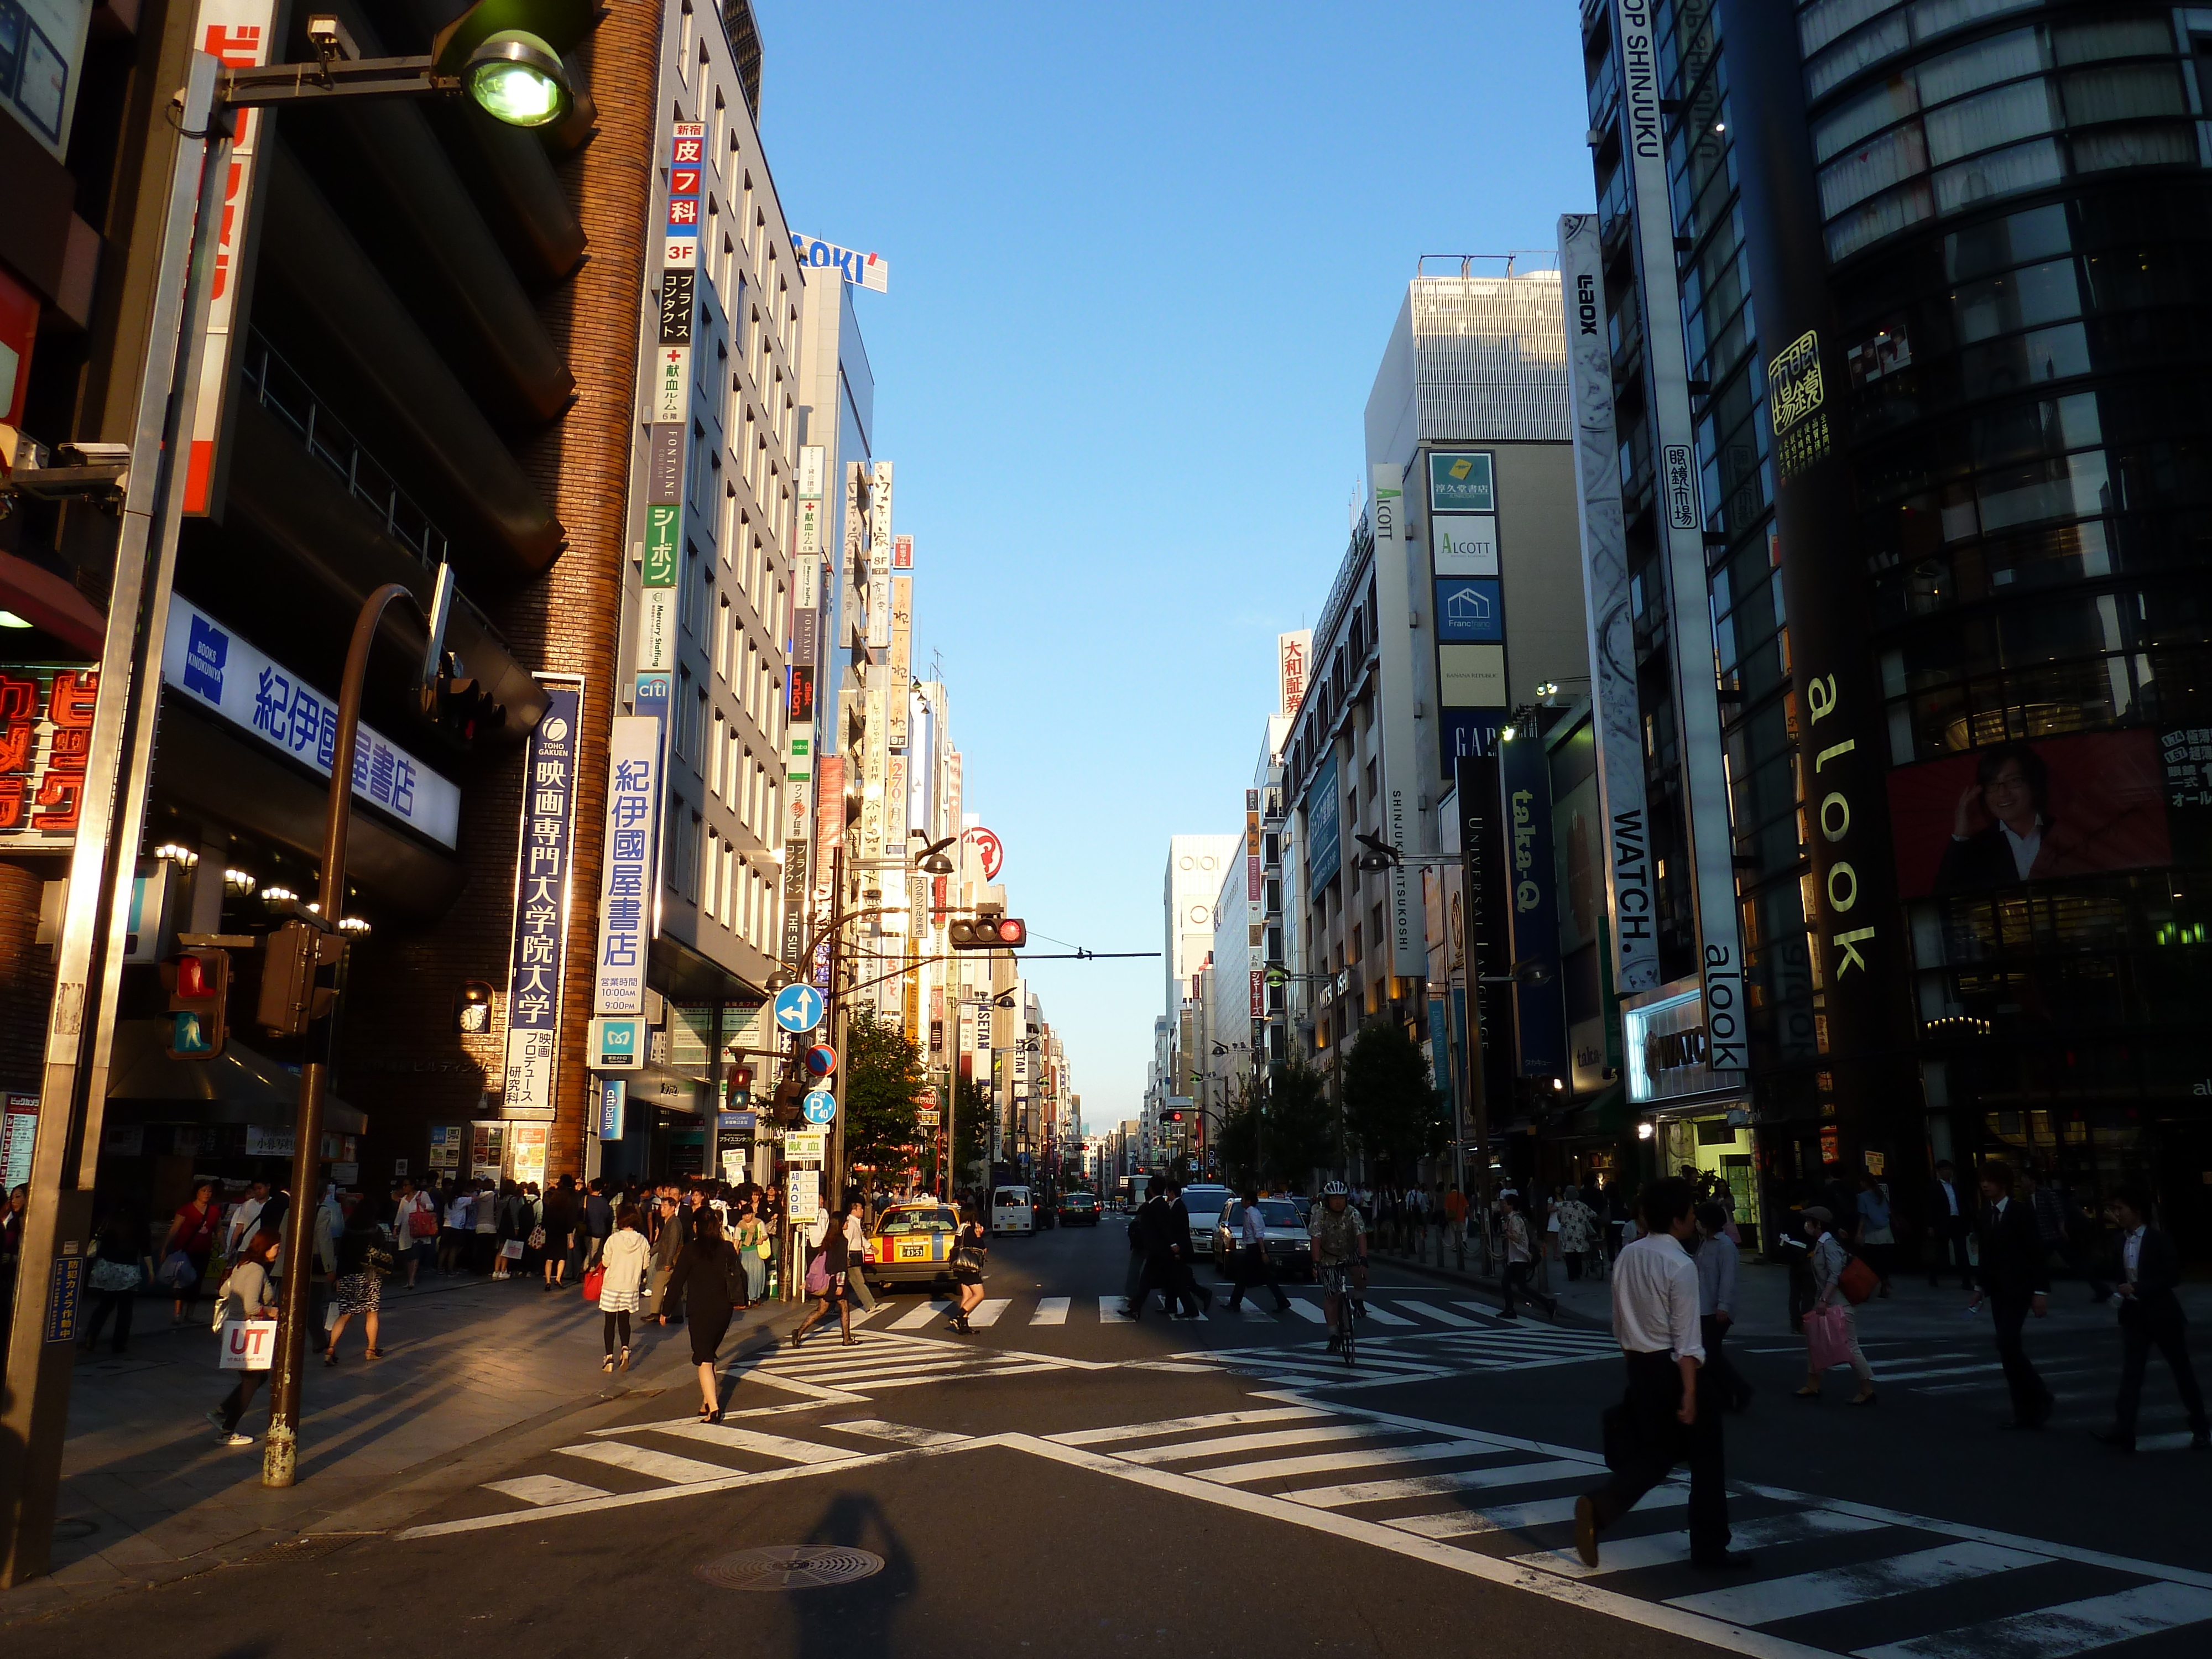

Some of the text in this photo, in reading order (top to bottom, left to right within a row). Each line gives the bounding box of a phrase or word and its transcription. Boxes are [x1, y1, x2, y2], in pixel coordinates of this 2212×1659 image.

[1626, 34, 1658, 158] SHINJUKU
[677, 125, 701, 135] 新宿
[671, 140, 699, 223] 皮フ科
[668, 247, 693, 259] 3F
[662, 275, 677, 337] コンタクト
[676, 275, 694, 337] プライス
[665, 364, 679, 410] 献血ルーム
[665, 431, 677, 497] FONTAINE
[1435, 484, 1488, 493] 淳久堂書店
[1669, 448, 1692, 526] 眼鏡市場
[804, 513, 813, 544] 献血ルーム
[1376, 486, 1401, 540] ALCOTT
[1442, 533, 1490, 554] ALCOTT
[197, 641, 217, 664] BOOKS
[652, 638, 662, 667] Staffing
[803, 614, 812, 660] FONTAINE
[188, 651, 221, 683] KINOKUNIYA
[1284, 640, 1302, 714] 大和証券
[639, 681, 666, 697] citi
[792, 671, 801, 716] union
[2163, 732, 2184, 746] 1.74
[2167, 748, 2185, 763] 1.67
[871, 750, 879, 780] 日本料理
[2169, 776, 2199, 788] 一式
[2172, 791, 2212, 808] オール
[1807, 672, 1875, 982] alook
[603, 759, 650, 966] 紀伊國屋書店
[785, 845, 794, 893] コンタクト
[796, 844, 806, 893] プライス
[1511, 788, 1541, 913] taka-Q
[518, 760, 566, 1024] 映画専門大学院大学
[915, 880, 925, 936] スクランブル交差点
[1396, 866, 1408, 951] MITSUKOSHI
[789, 911, 798, 932] THE
[787, 935, 797, 963] SUIT
[601, 978, 638, 987] 営業時間
[1252, 972, 1262, 1015] シェーキーズ
[605, 1001, 635, 1010] 9:00PM
[1705, 943, 1746, 1067] alook
[538, 1032, 551, 1057] 映画
[506, 1066, 521, 1104] 研究科
[520, 1032, 538, 1102] プロデュース
[604, 1089, 615, 1130] citibank
[810, 1098, 823, 1119] P
[819, 1109, 828, 1119] 40
[791, 1183, 799, 1192] A
[791, 1194, 799, 1203] O
[59, 1260, 79, 1338] 防犯カメラ作動中
[230, 1328, 269, 1354] UT
